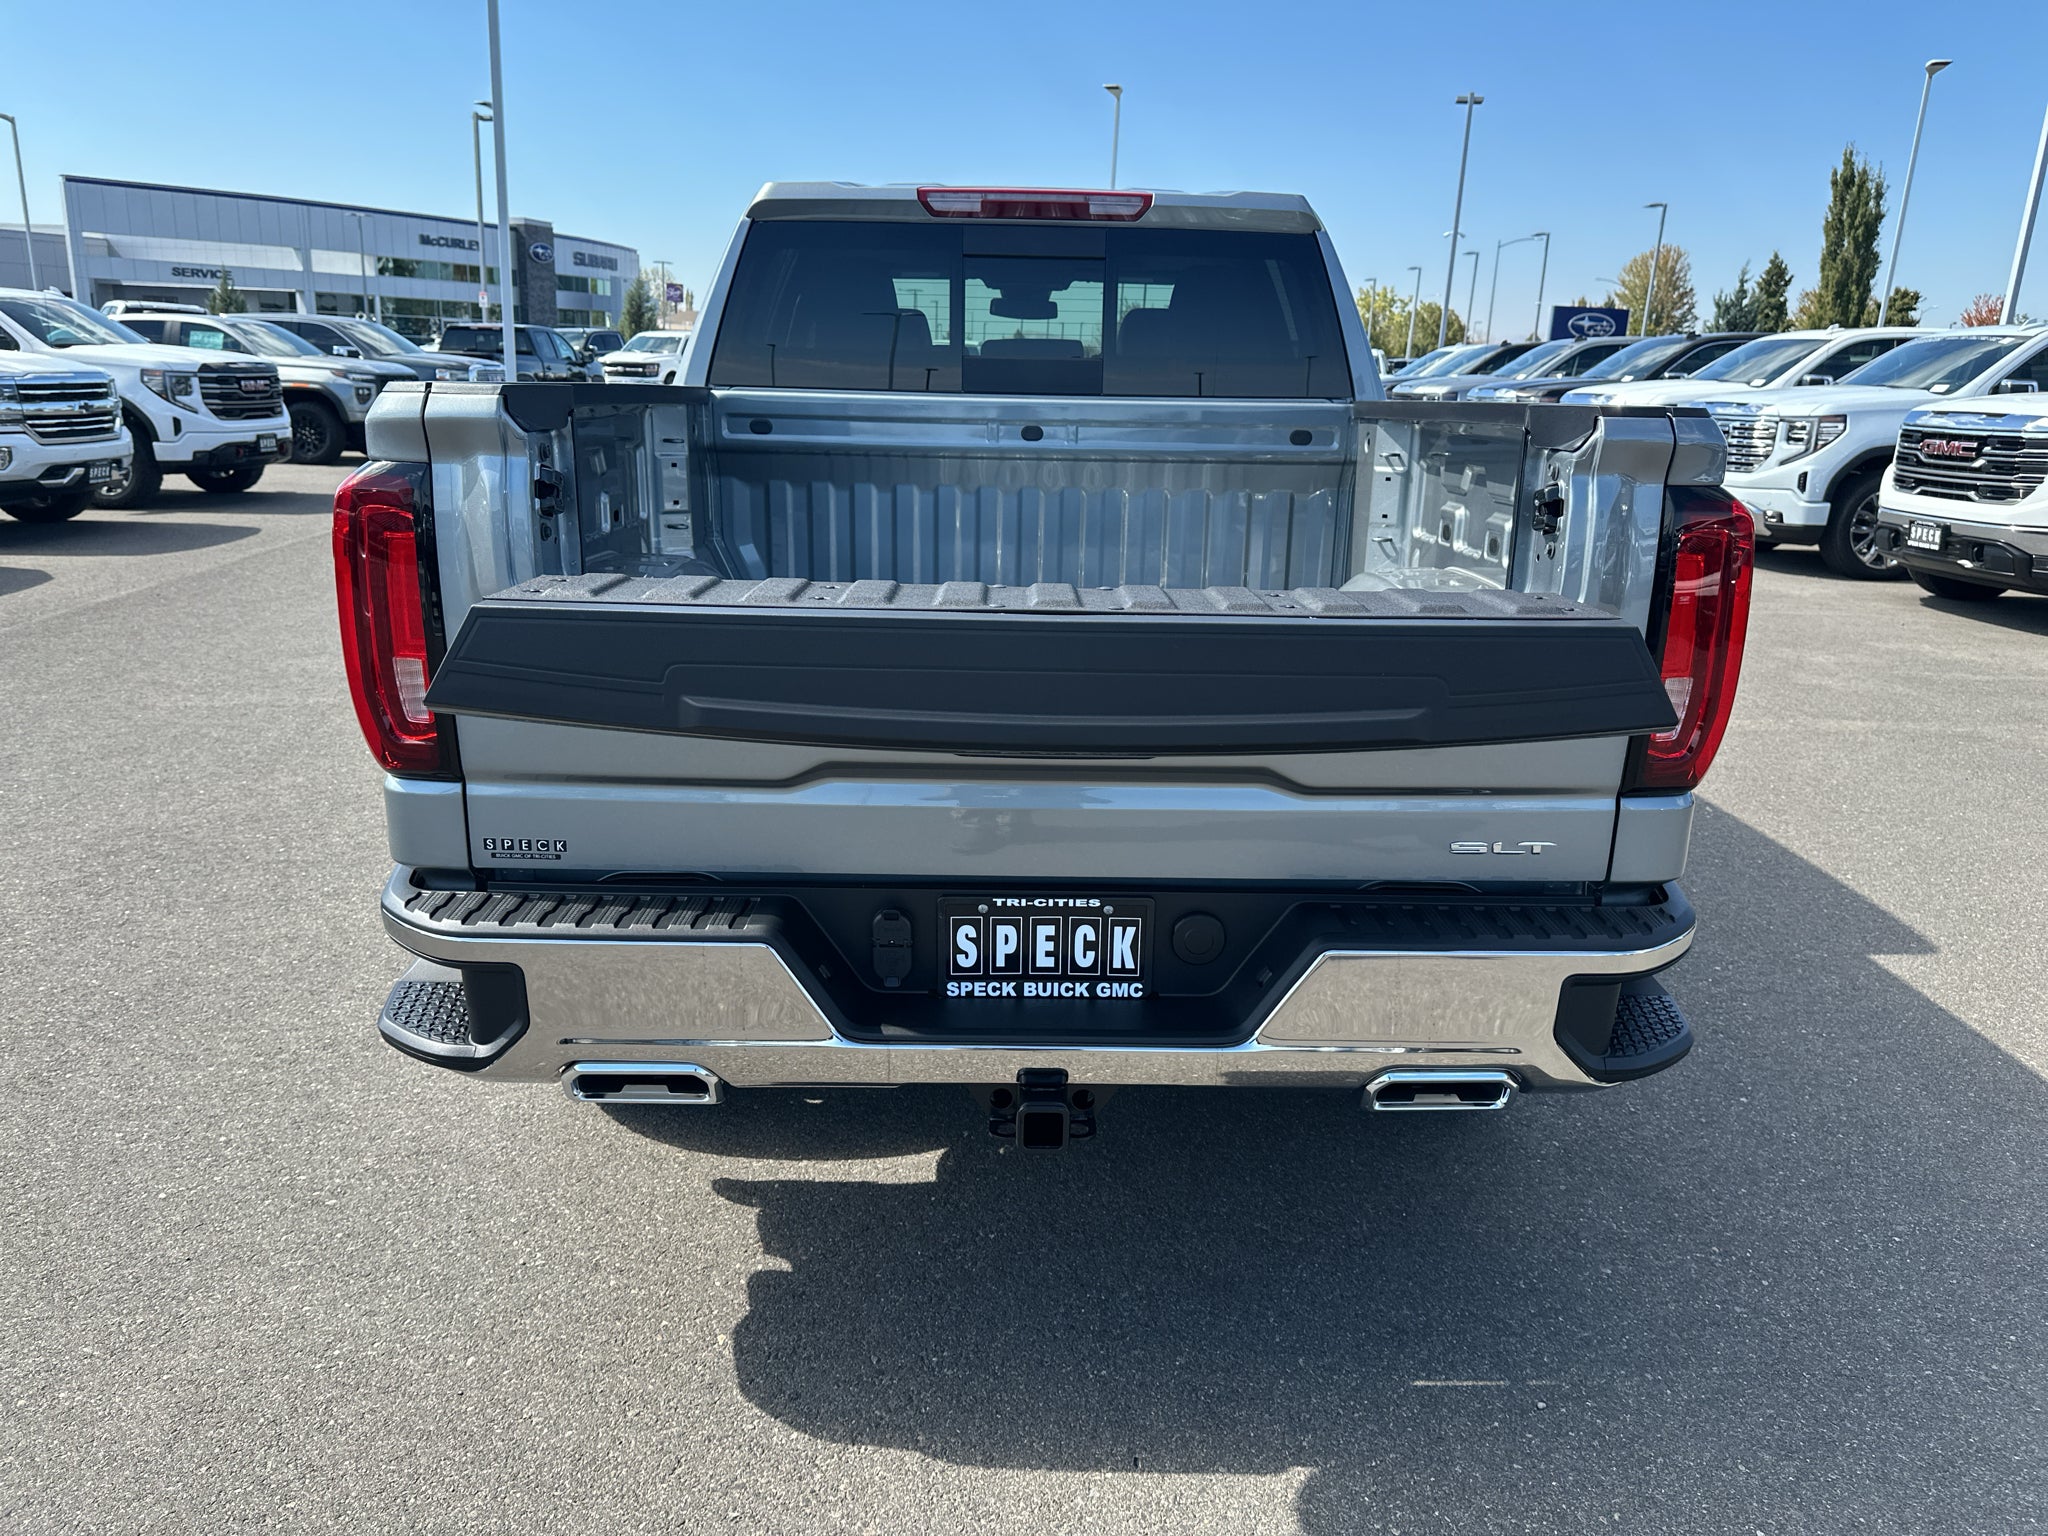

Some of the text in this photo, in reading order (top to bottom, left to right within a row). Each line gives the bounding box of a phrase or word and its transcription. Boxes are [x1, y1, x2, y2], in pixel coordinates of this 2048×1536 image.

[419, 233, 479, 251] McCURLE
[171, 266, 233, 280] SERVICE
[1920, 438, 1978, 457] GMC
[1910, 526, 1941, 544] SPECK
[485, 838, 565, 852] SPECK
[1450, 841, 1558, 854] SLT
[992, 898, 1101, 908] TRI-CITIES
[956, 924, 1137, 969] SPECK
[946, 981, 1144, 998] SPECK BUICK GMC
